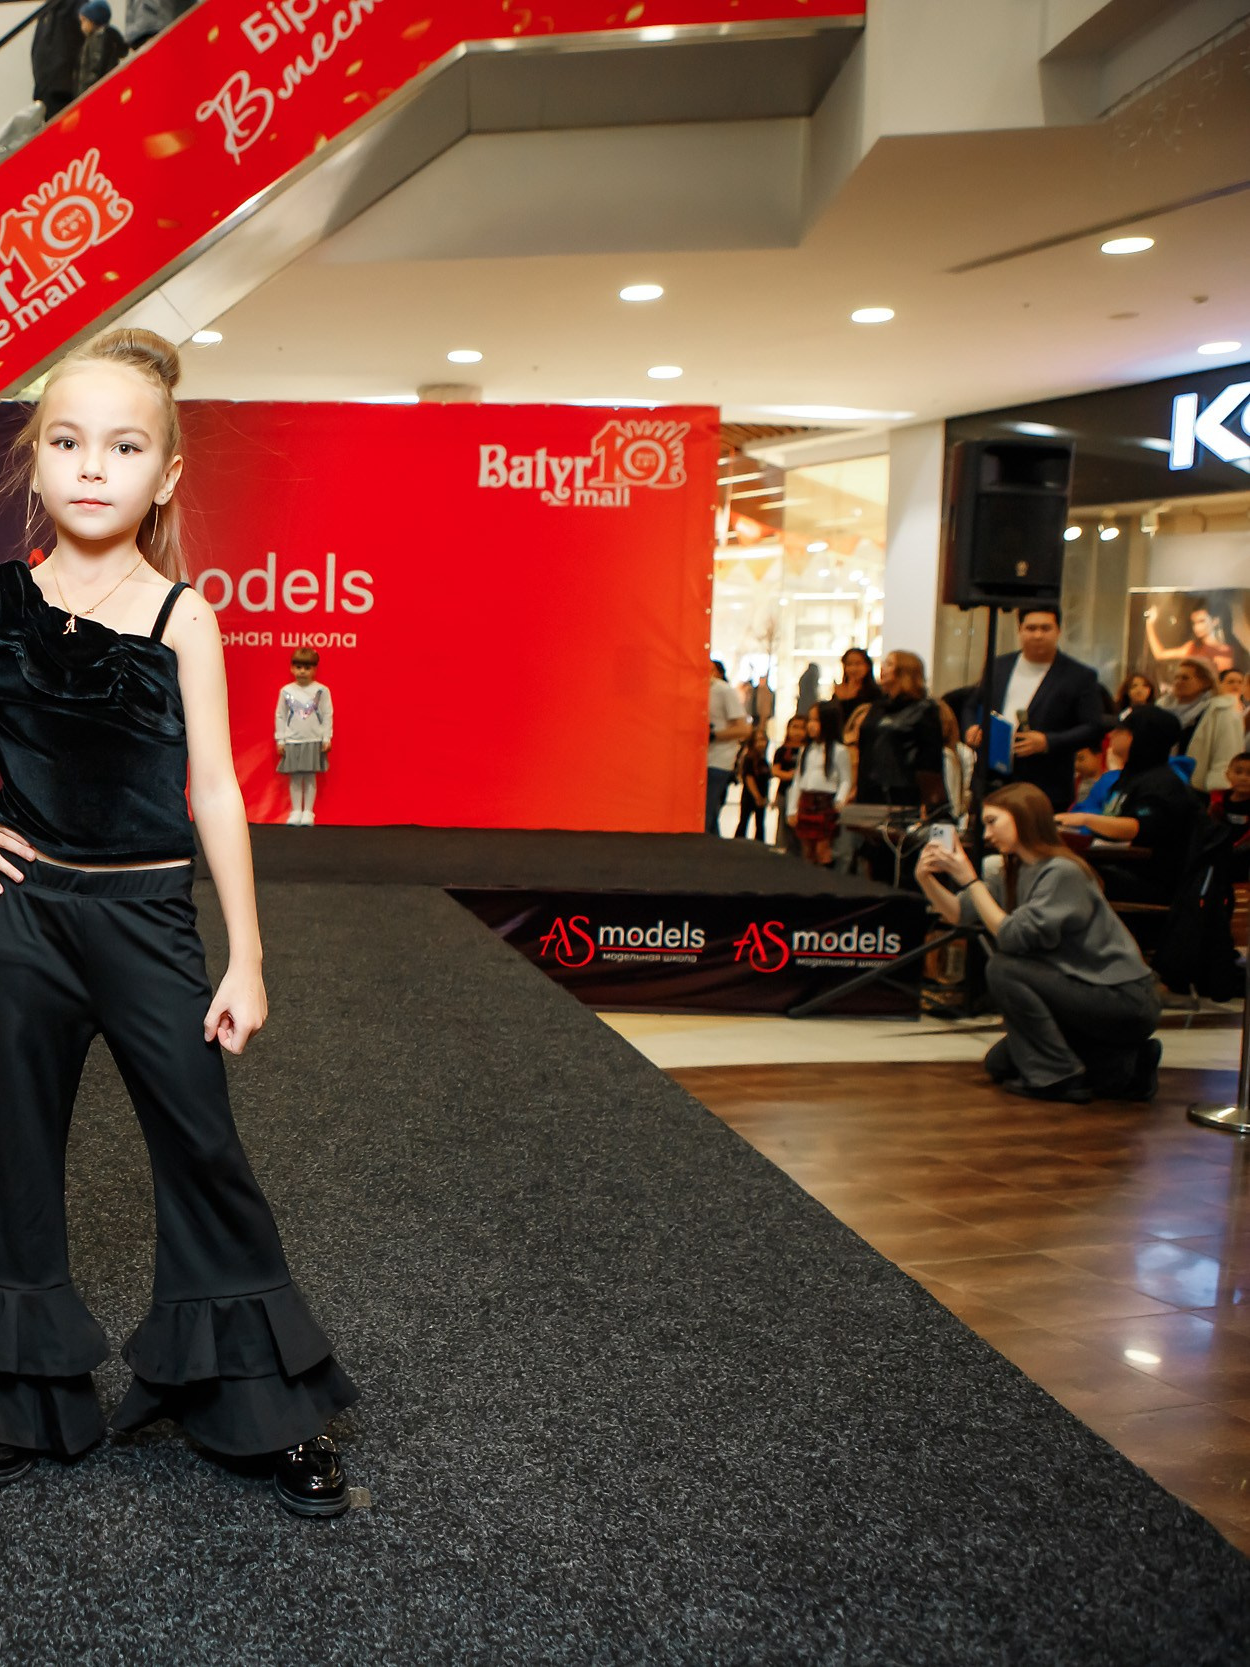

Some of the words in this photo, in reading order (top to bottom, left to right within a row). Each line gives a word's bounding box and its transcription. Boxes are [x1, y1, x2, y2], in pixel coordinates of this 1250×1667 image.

[240, 0, 330, 53] Бір
[12, 265, 86, 331] mall
[1169, 381, 1250, 471] K
[478, 444, 593, 500] Batyr
[574, 487, 630, 507] mall
[196, 552, 375, 614] odels
[281, 632, 357, 648] школа
[540, 915, 595, 968] AS
[599, 920, 706, 949] models
[733, 920, 789, 973] AS
[793, 925, 901, 953] models
